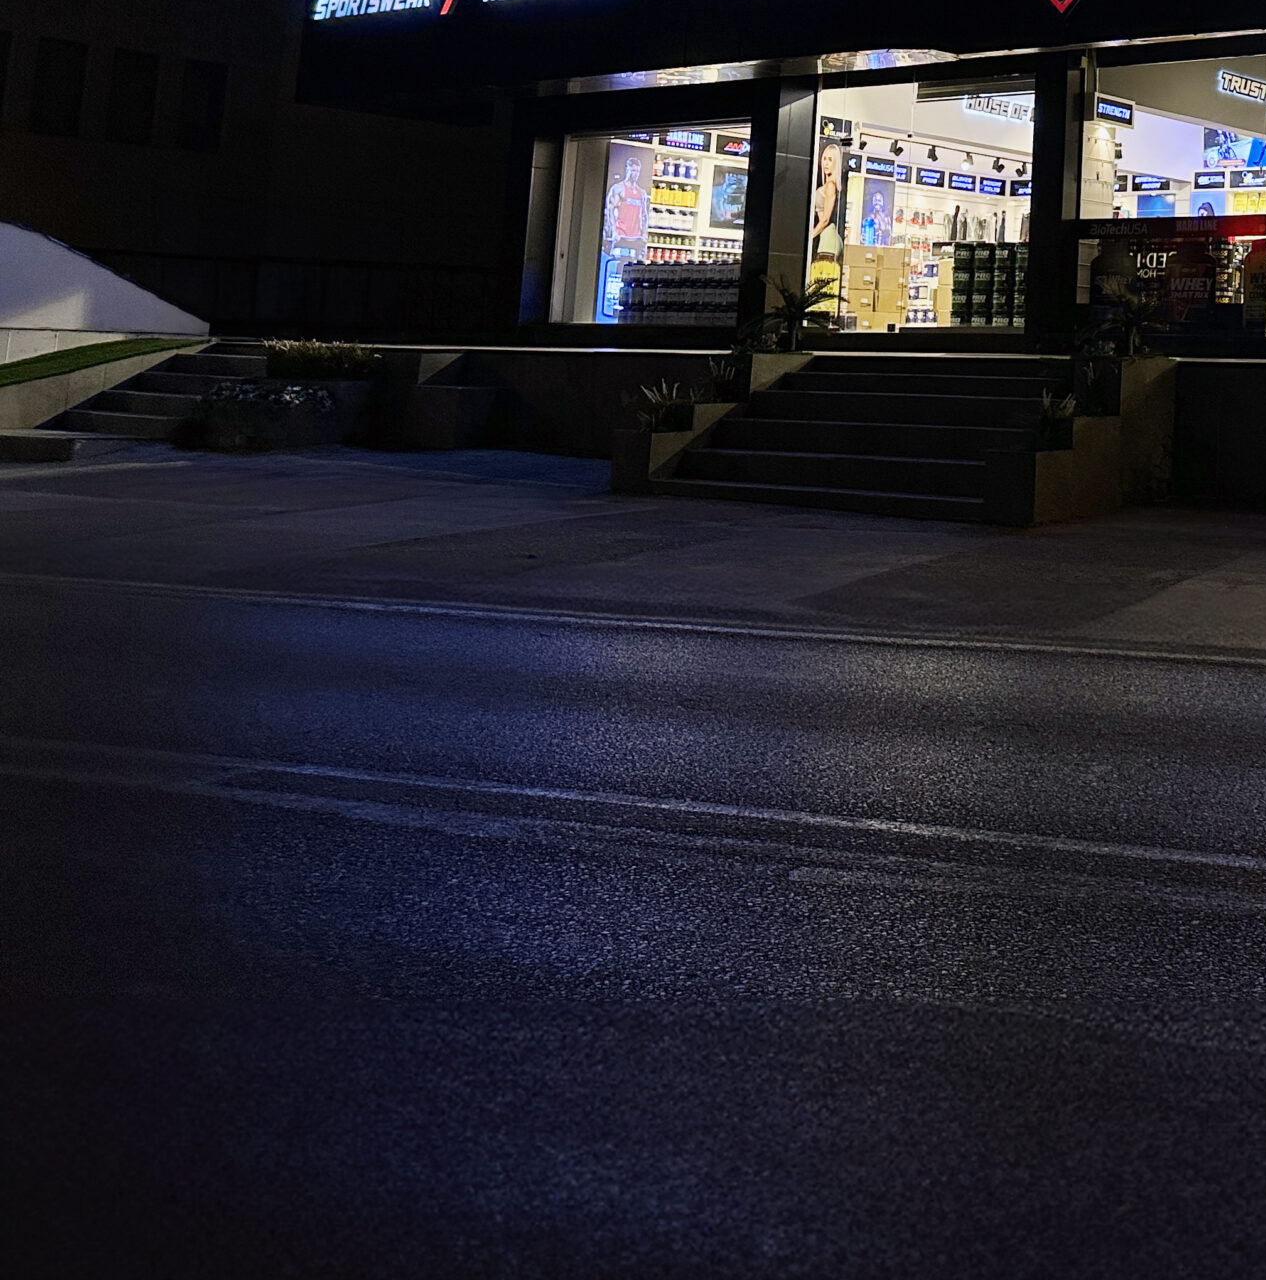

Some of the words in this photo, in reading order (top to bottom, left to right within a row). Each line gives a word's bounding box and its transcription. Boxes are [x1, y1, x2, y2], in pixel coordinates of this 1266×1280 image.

[965, 96, 1009, 117] HOUSE
[1010, 102, 1029, 121] OF
[1170, 277, 1214, 291] WHEY
